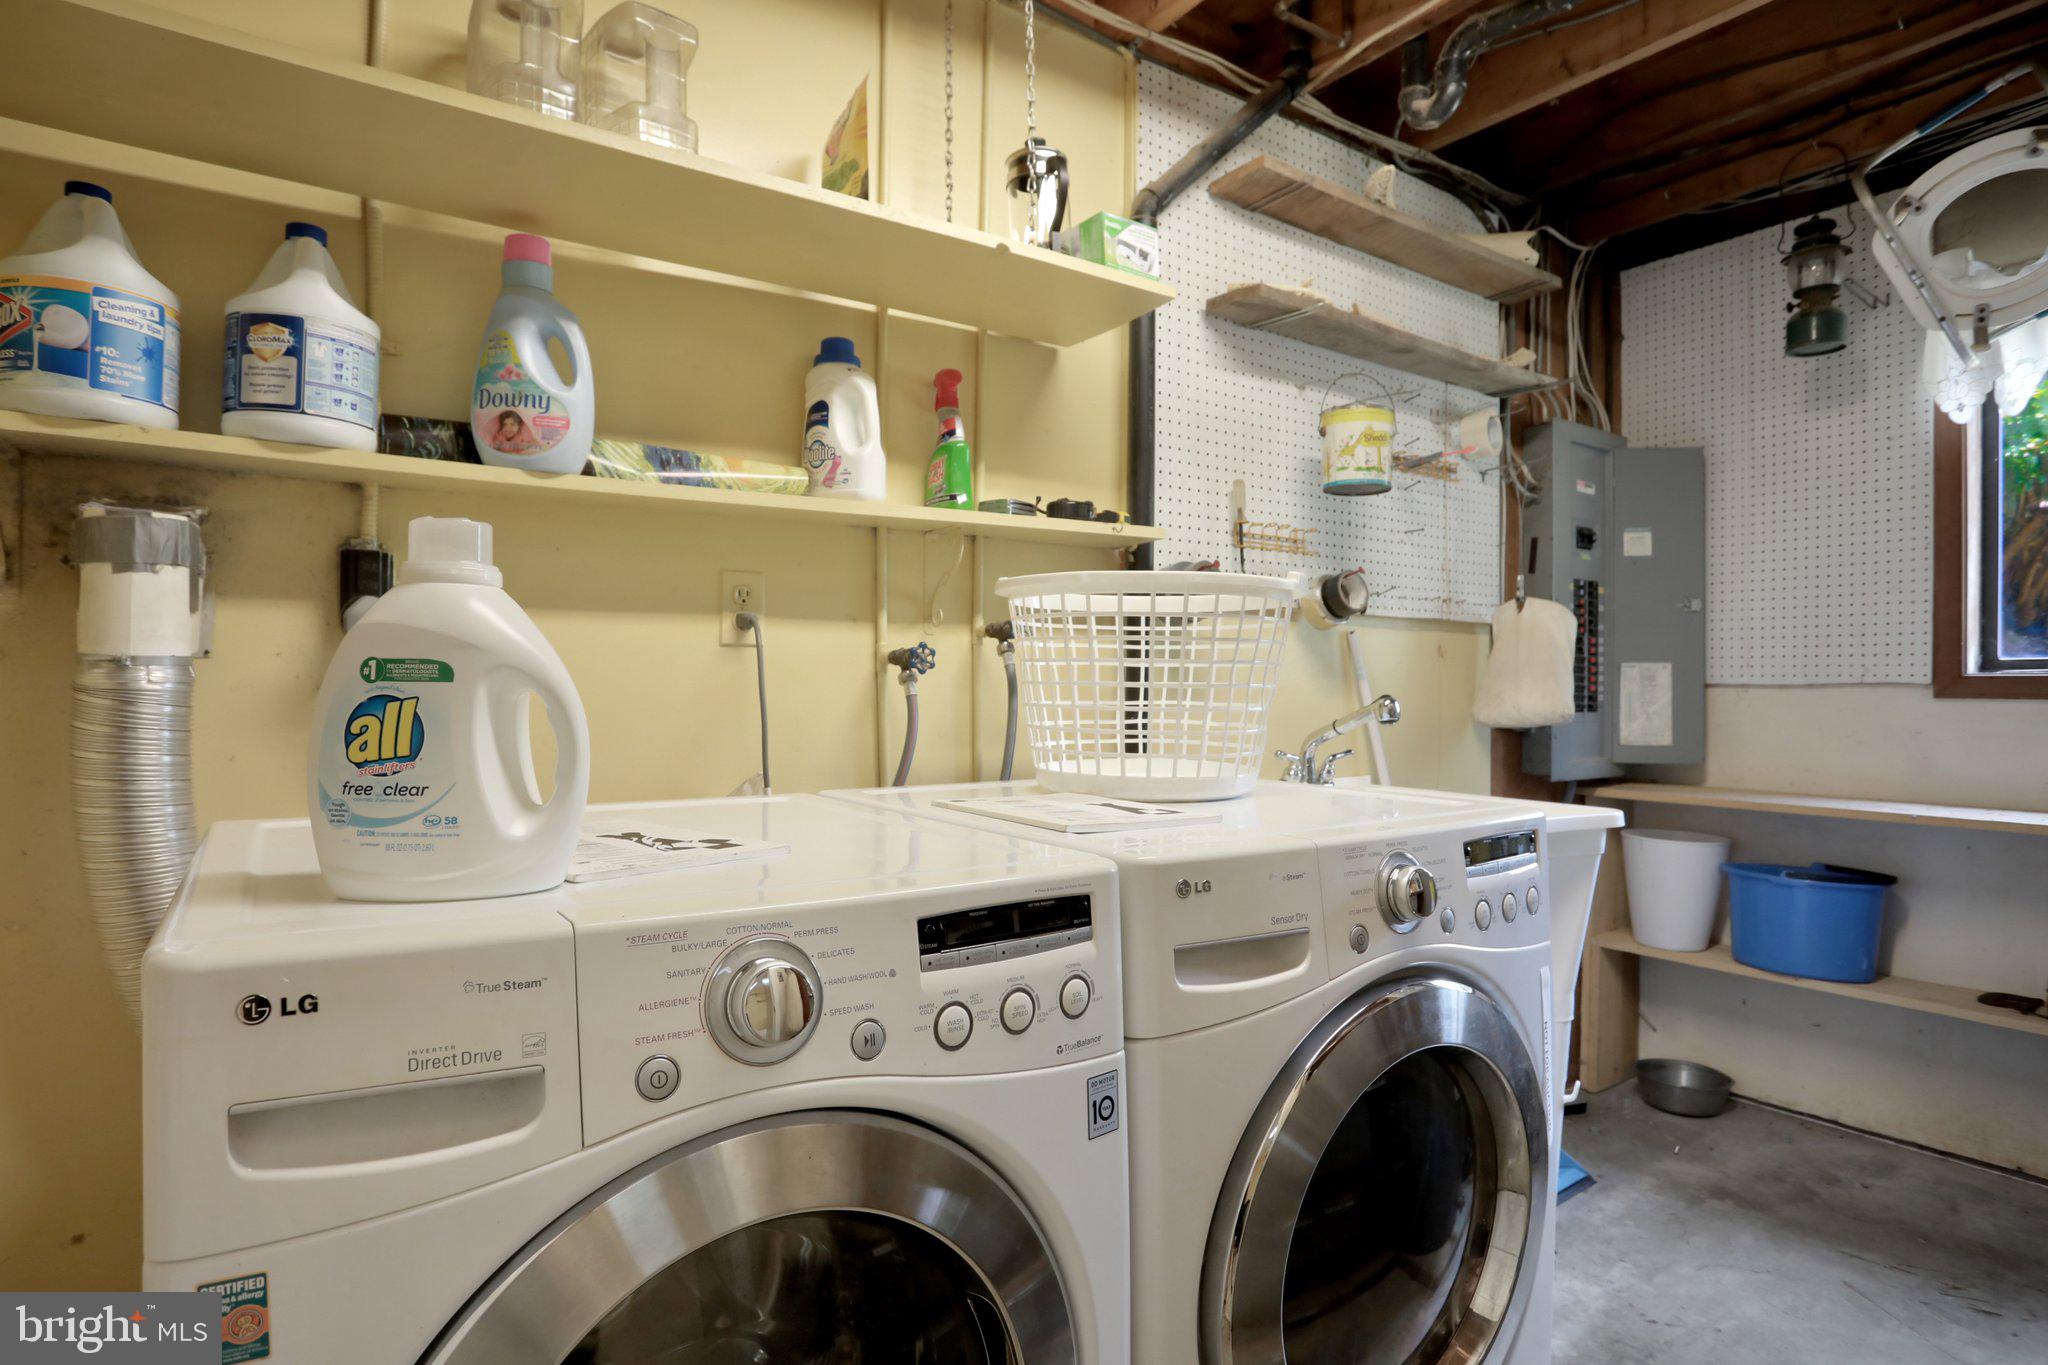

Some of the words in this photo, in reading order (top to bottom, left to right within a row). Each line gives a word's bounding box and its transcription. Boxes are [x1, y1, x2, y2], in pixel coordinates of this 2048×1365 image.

[98, 300, 147, 318] Cleaning
[150, 309, 155, 318] &
[102, 310, 144, 330] laundry
[147, 323, 161, 336] tips
[99, 357, 143, 372] Removes
[479, 388, 551, 414] Downy
[363, 659, 377, 681] #1
[346, 696, 420, 764] all
[358, 761, 417, 777] stainlifters
[342, 781, 373, 796] free
[383, 782, 429, 797] clear
[444, 816, 458, 825] 58
[1194, 880, 1212, 894] LG
[1271, 915, 1294, 925] Sensor
[1296, 912, 1309, 922] Dry
[662, 930, 688, 942] CYCLE
[816, 926, 839, 935] PRESS
[671, 939, 728, 953] BULKY/LARGE
[817, 947, 855, 959] DELICATES
[666, 967, 707, 979] SANITARY
[828, 975, 847, 985] HAND
[848, 971, 887, 982] WASH/WOOL
[943, 988, 959, 996] WARM
[280, 993, 319, 1017] LG
[829, 1006, 852, 1016] SPEED
[853, 1003, 875, 1013] WASH
[1012, 1010, 1029, 1019] SPEED
[635, 1034, 665, 1046] STEAM
[407, 1045, 457, 1055] INVERTER
[407, 1053, 458, 1073] Direct
[461, 1047, 503, 1066] Drive
[1099, 1075, 1115, 1085] MOTOR
[1092, 1095, 1115, 1125] 10
[200, 1276, 265, 1295] RTIFIED
[237, 1290, 264, 1301] allergy
